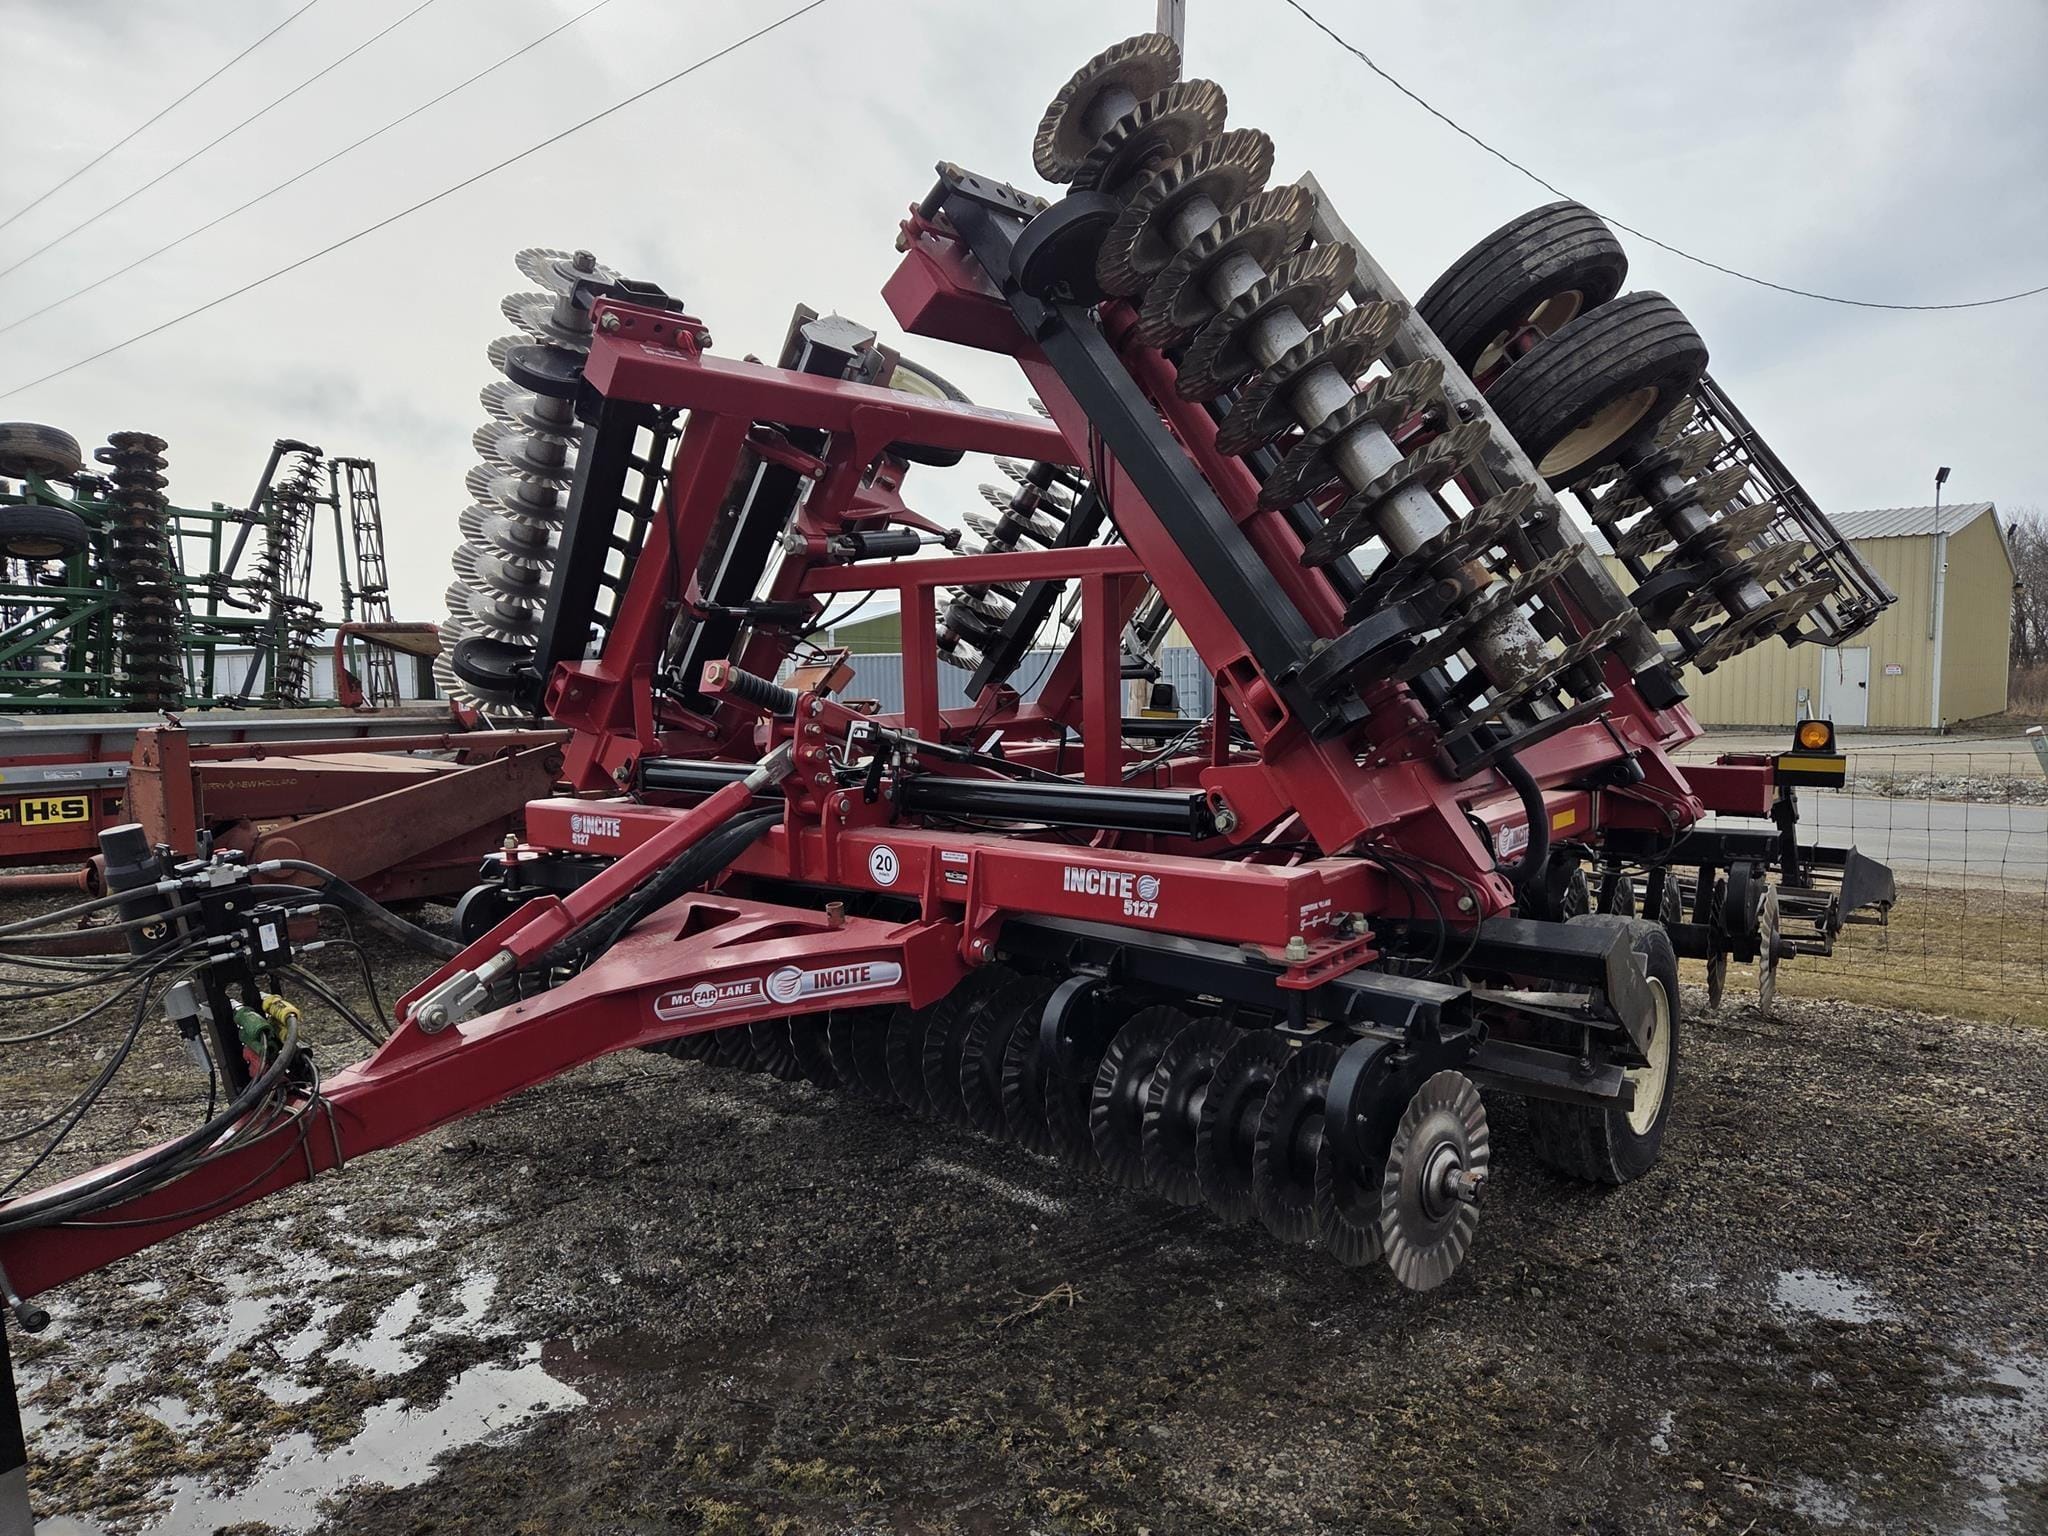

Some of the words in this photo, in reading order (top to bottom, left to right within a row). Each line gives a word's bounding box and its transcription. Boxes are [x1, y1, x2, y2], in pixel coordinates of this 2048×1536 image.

[25, 799, 84, 821] H&S
[582, 815, 621, 837] INCITE
[572, 832, 590, 846] 5127
[875, 854, 893, 872] 20
[1063, 866, 1133, 899] INCITE
[1123, 899, 1158, 919] 5127
[814, 965, 871, 989] INCITE
